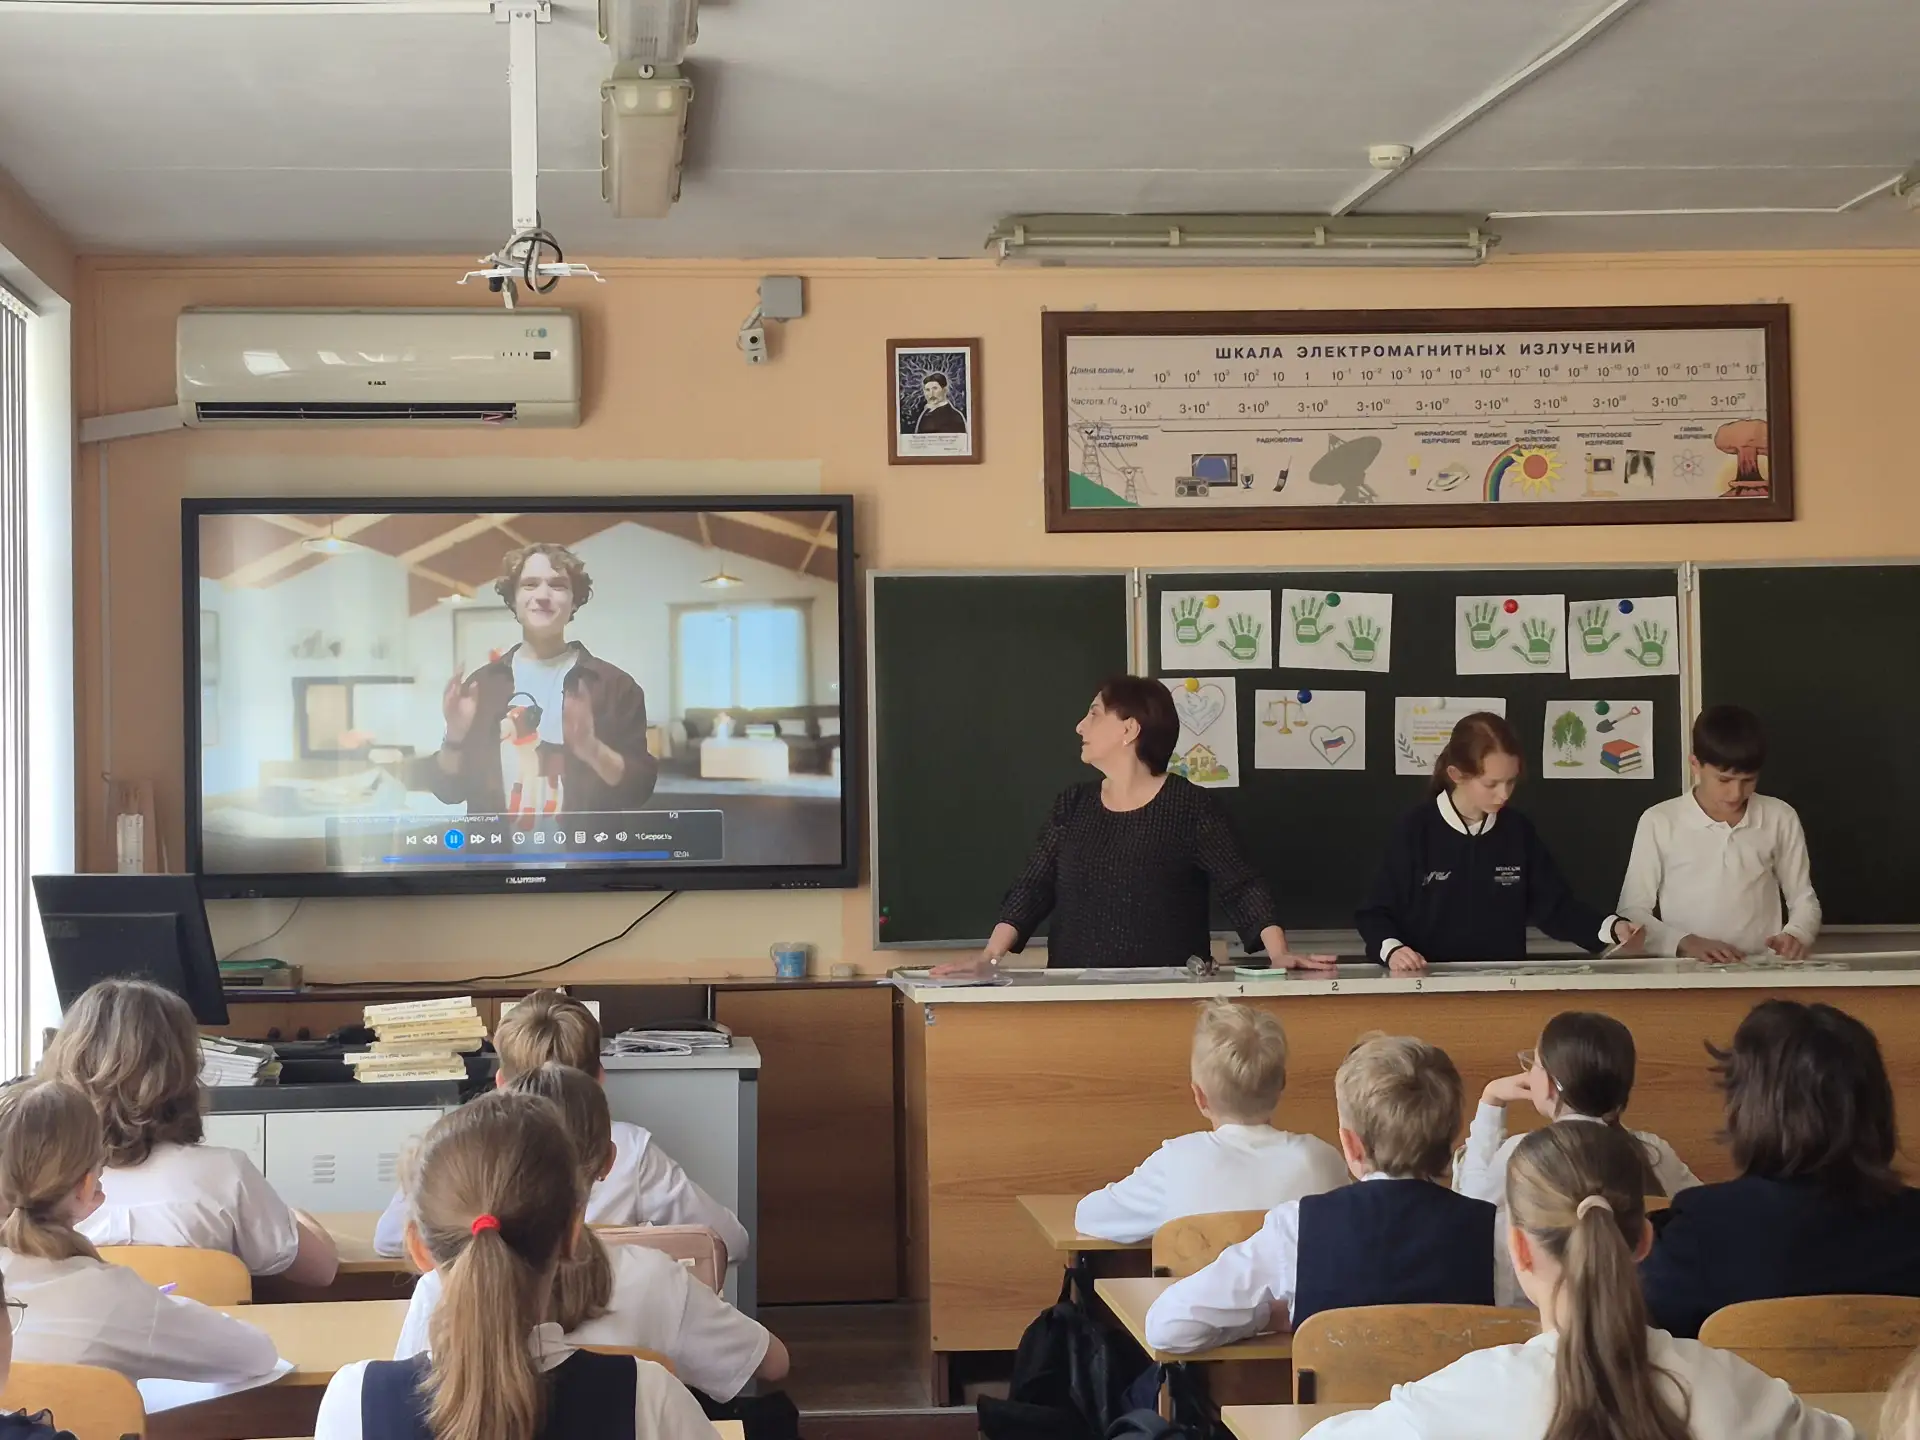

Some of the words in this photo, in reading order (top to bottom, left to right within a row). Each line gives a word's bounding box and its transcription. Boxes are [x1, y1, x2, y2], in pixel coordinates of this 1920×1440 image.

[1215, 346, 1283, 359] ШКАЛА
[1296, 343, 1506, 359] ЭЛЕКТРОМАГНИТНЫХ
[1520, 340, 1636, 356] ИЗЛУЧЕНИЙ
[1070, 366, 1096, 375] Длина
[1273, 371, 1285, 382] 10
[1305, 371, 1310, 381] 1
[1331, 981, 1340, 991] 2
[1415, 979, 1422, 990] 3
[1509, 977, 1517, 988] 4
